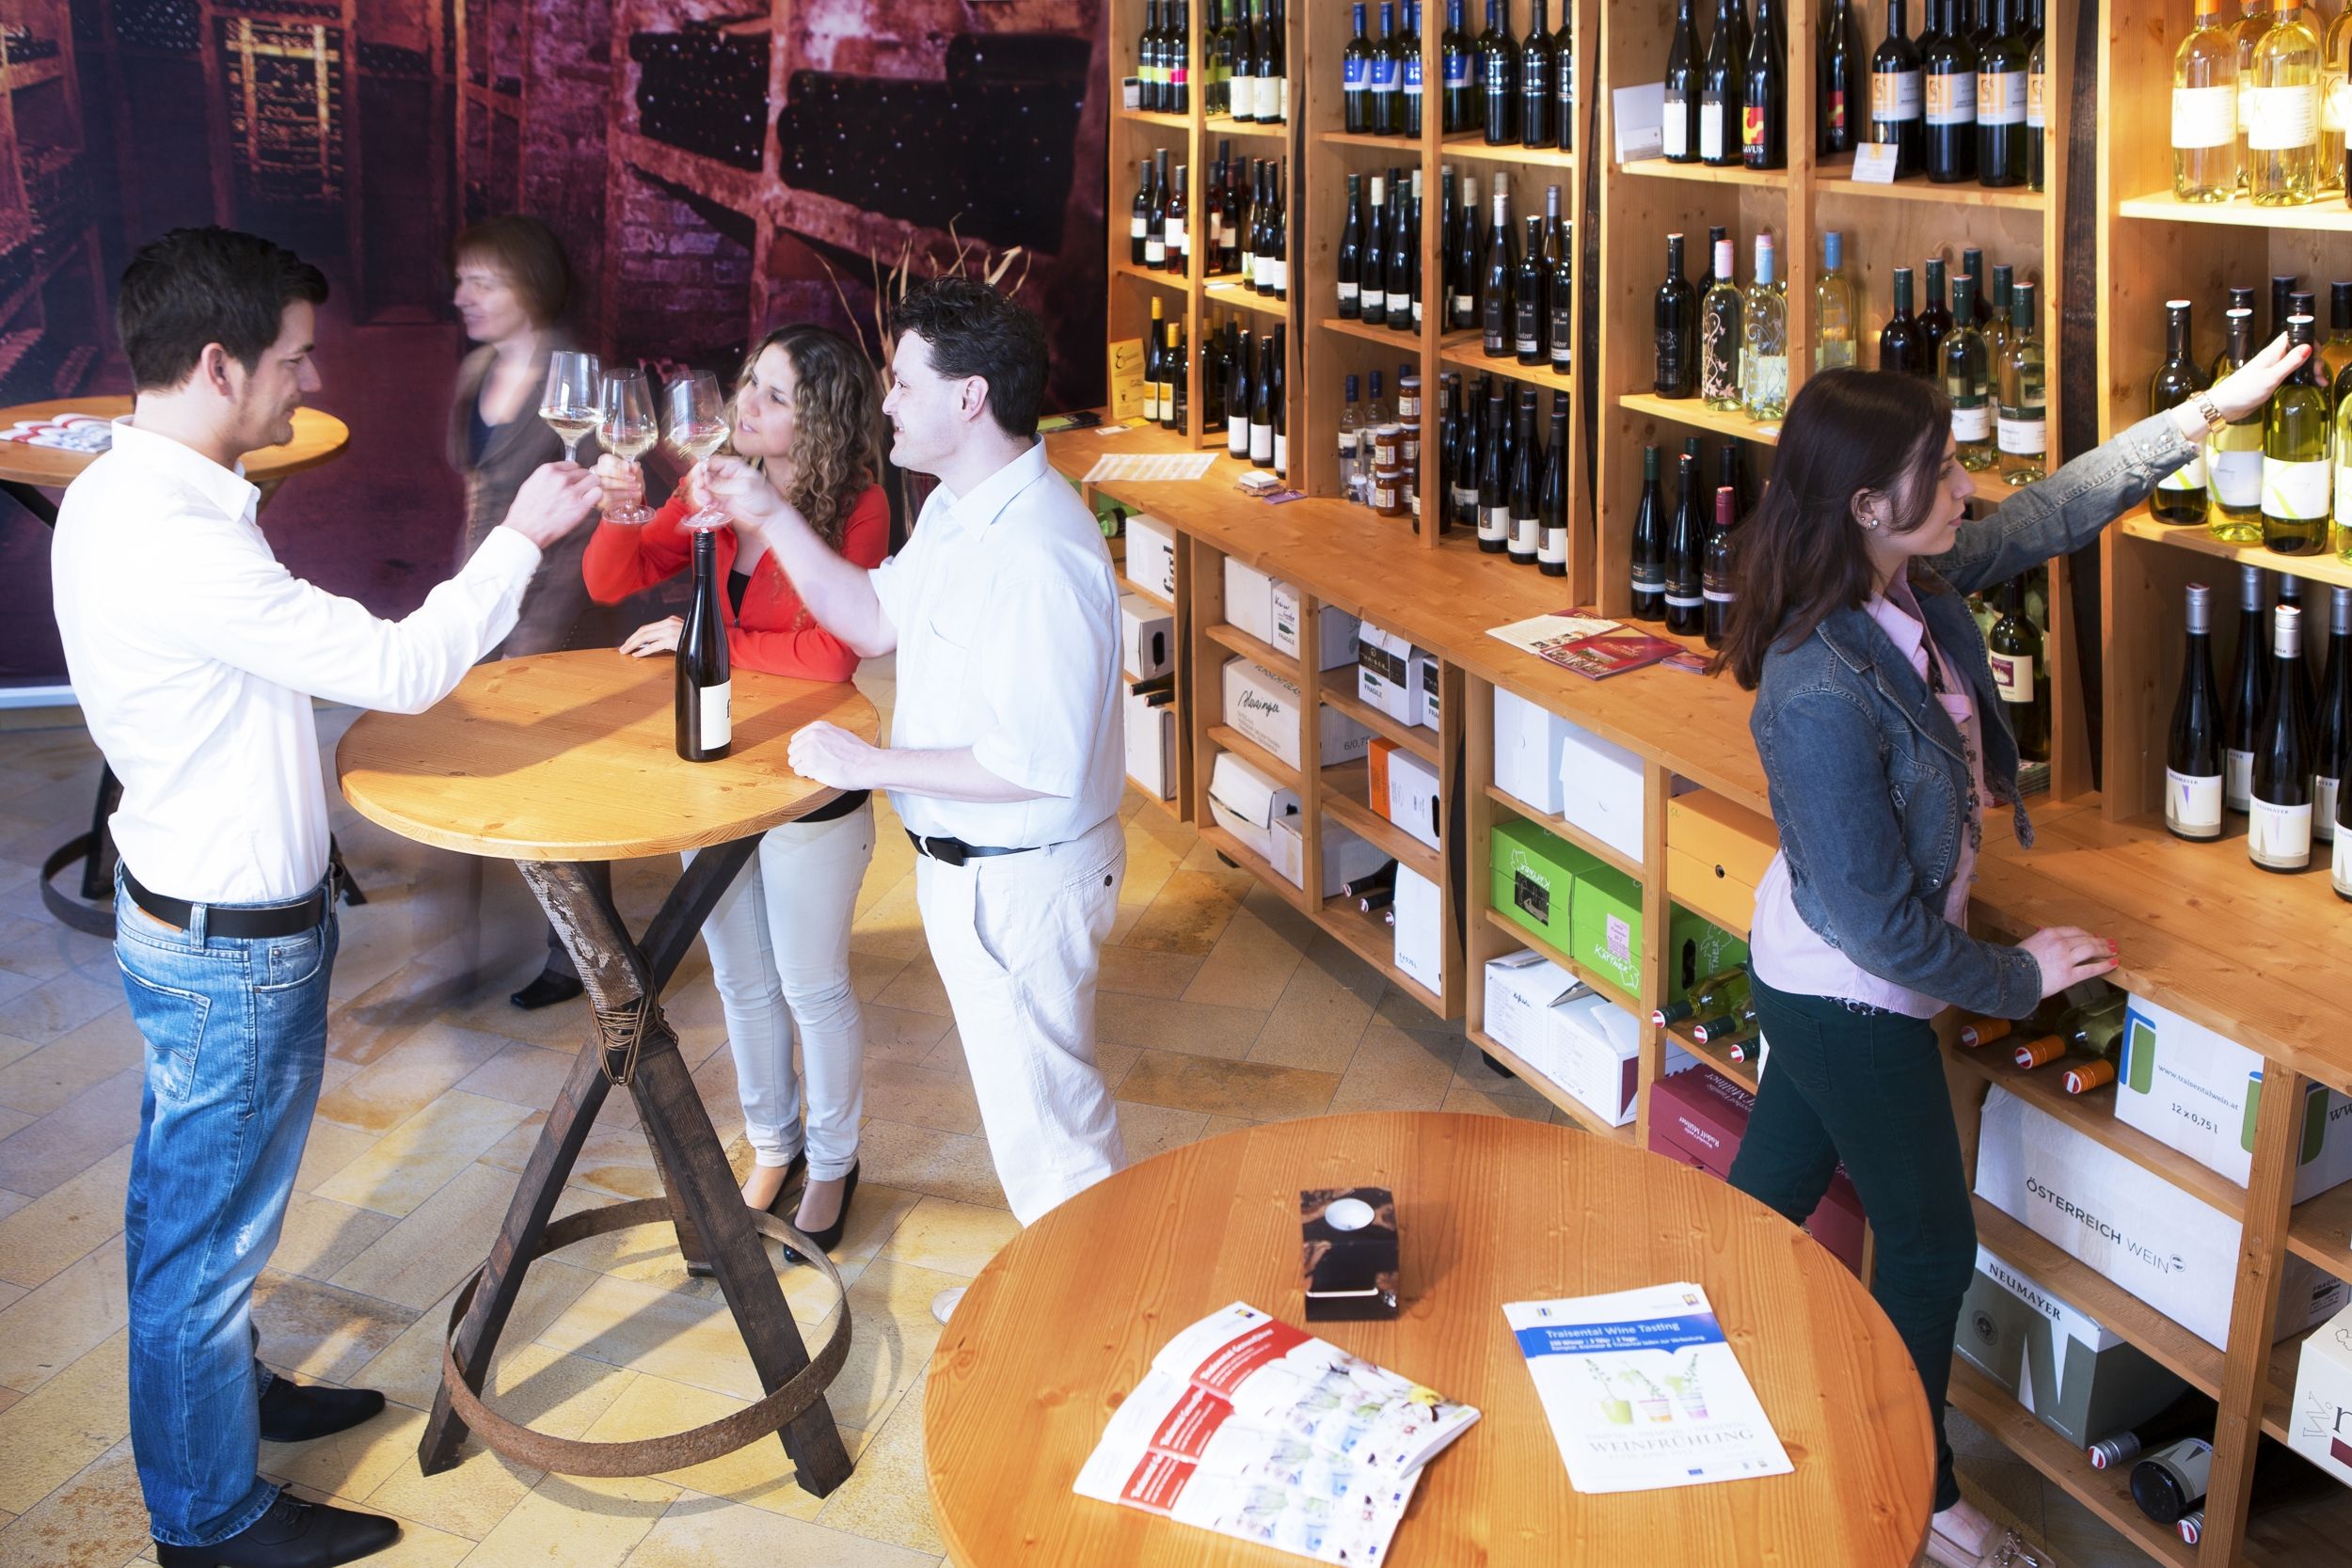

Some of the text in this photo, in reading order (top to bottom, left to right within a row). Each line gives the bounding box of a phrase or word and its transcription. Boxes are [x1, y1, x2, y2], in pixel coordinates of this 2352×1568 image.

[1364, 683, 1383, 700] FRAGILE
[2158, 1064, 2239, 1111] www.traisentalwein.at
[2171, 1102, 2182, 1115] 12
[2184, 1110, 2189, 1119] x
[2191, 1113, 2212, 1131] 0,75
[2026, 1176, 2169, 1275] ÖSTERREICH WEIN
[1989, 1262, 2061, 1322] NEUMAYER
[1546, 1322, 1681, 1339] Traisental Wine Tasting
[1589, 1428, 1755, 1453] WEINFRÜHLING
